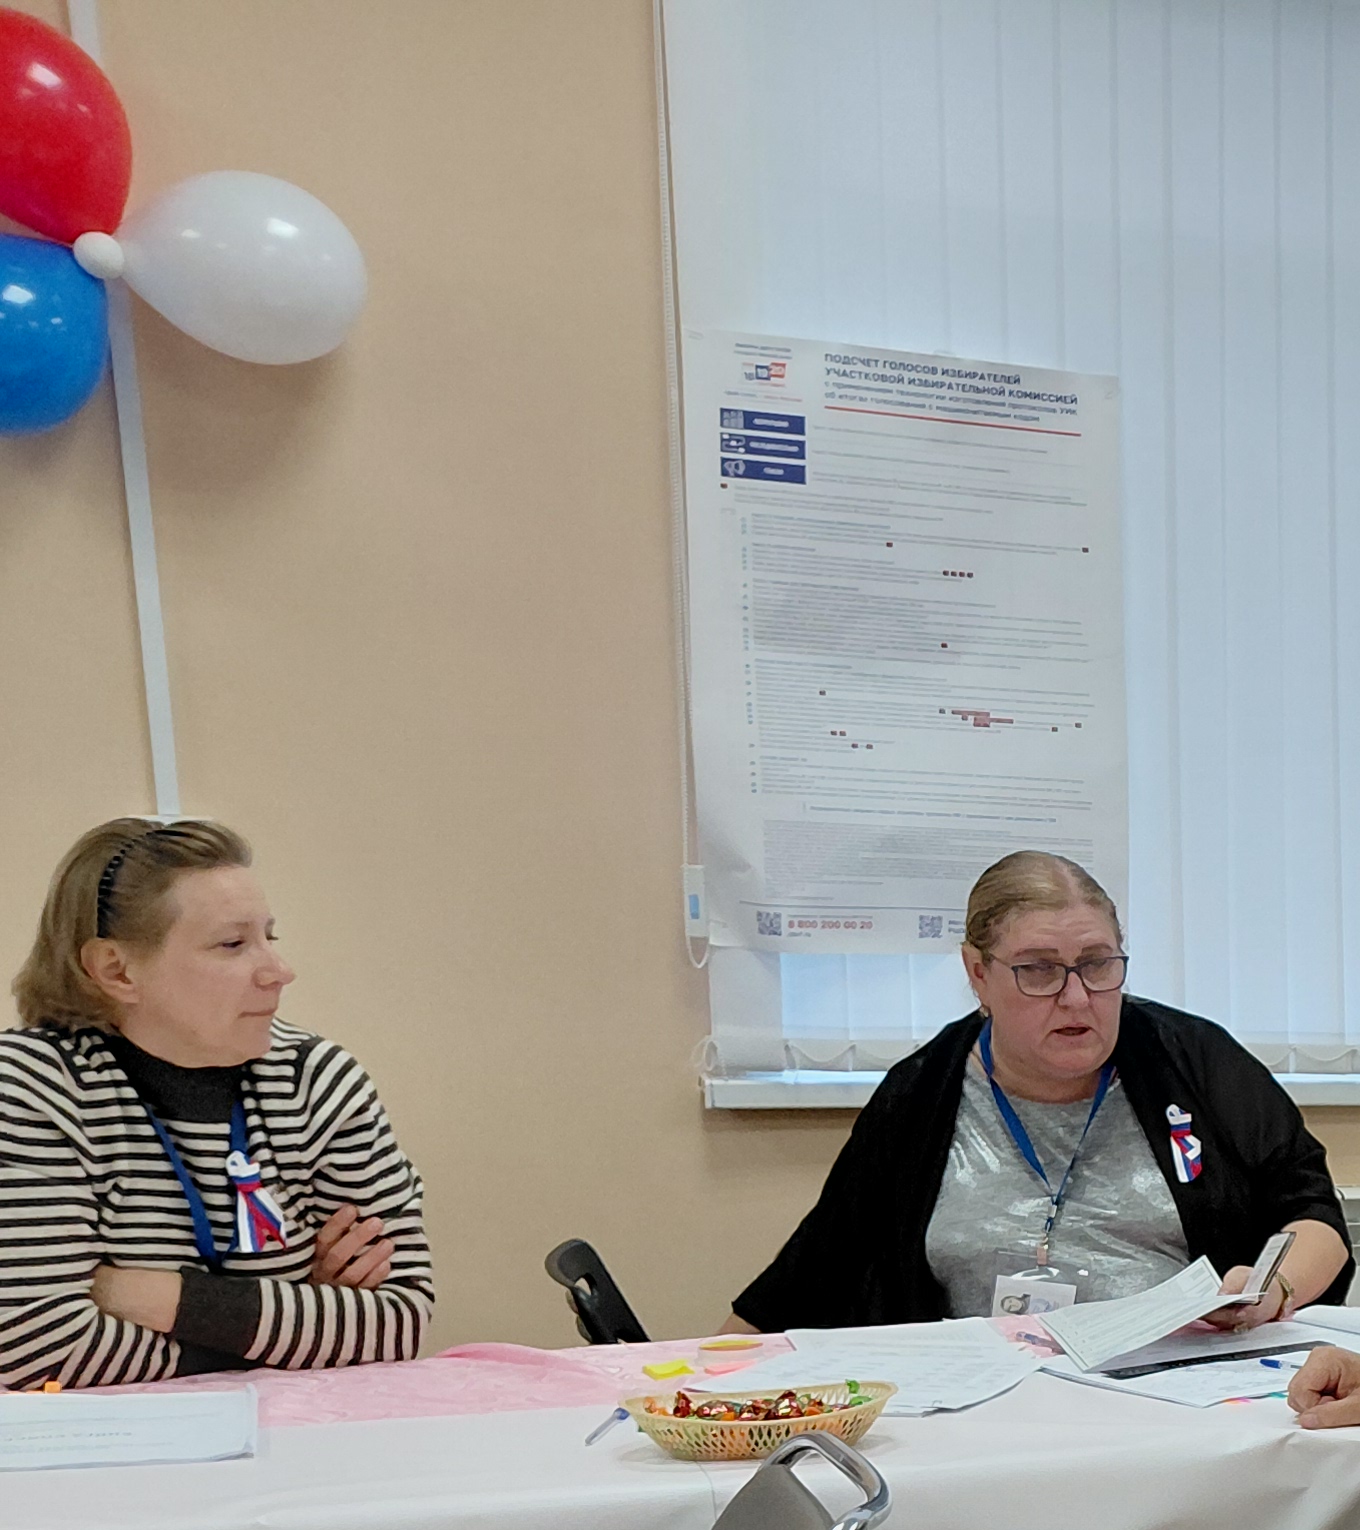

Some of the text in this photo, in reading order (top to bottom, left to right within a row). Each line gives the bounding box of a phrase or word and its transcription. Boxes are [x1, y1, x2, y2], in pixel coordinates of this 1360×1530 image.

[824, 352, 1022, 385] ПОДСЧЕТ ГОЛОСОВ ИЗБИРАТЕЛЕЙ
[824, 368, 906, 385] УЧАСТКОВОЙ
[907, 376, 1007, 397] ИЗБИРАТЕЛЬНОЙ
[1008, 388, 1079, 405] КОМИССИЕЙ
